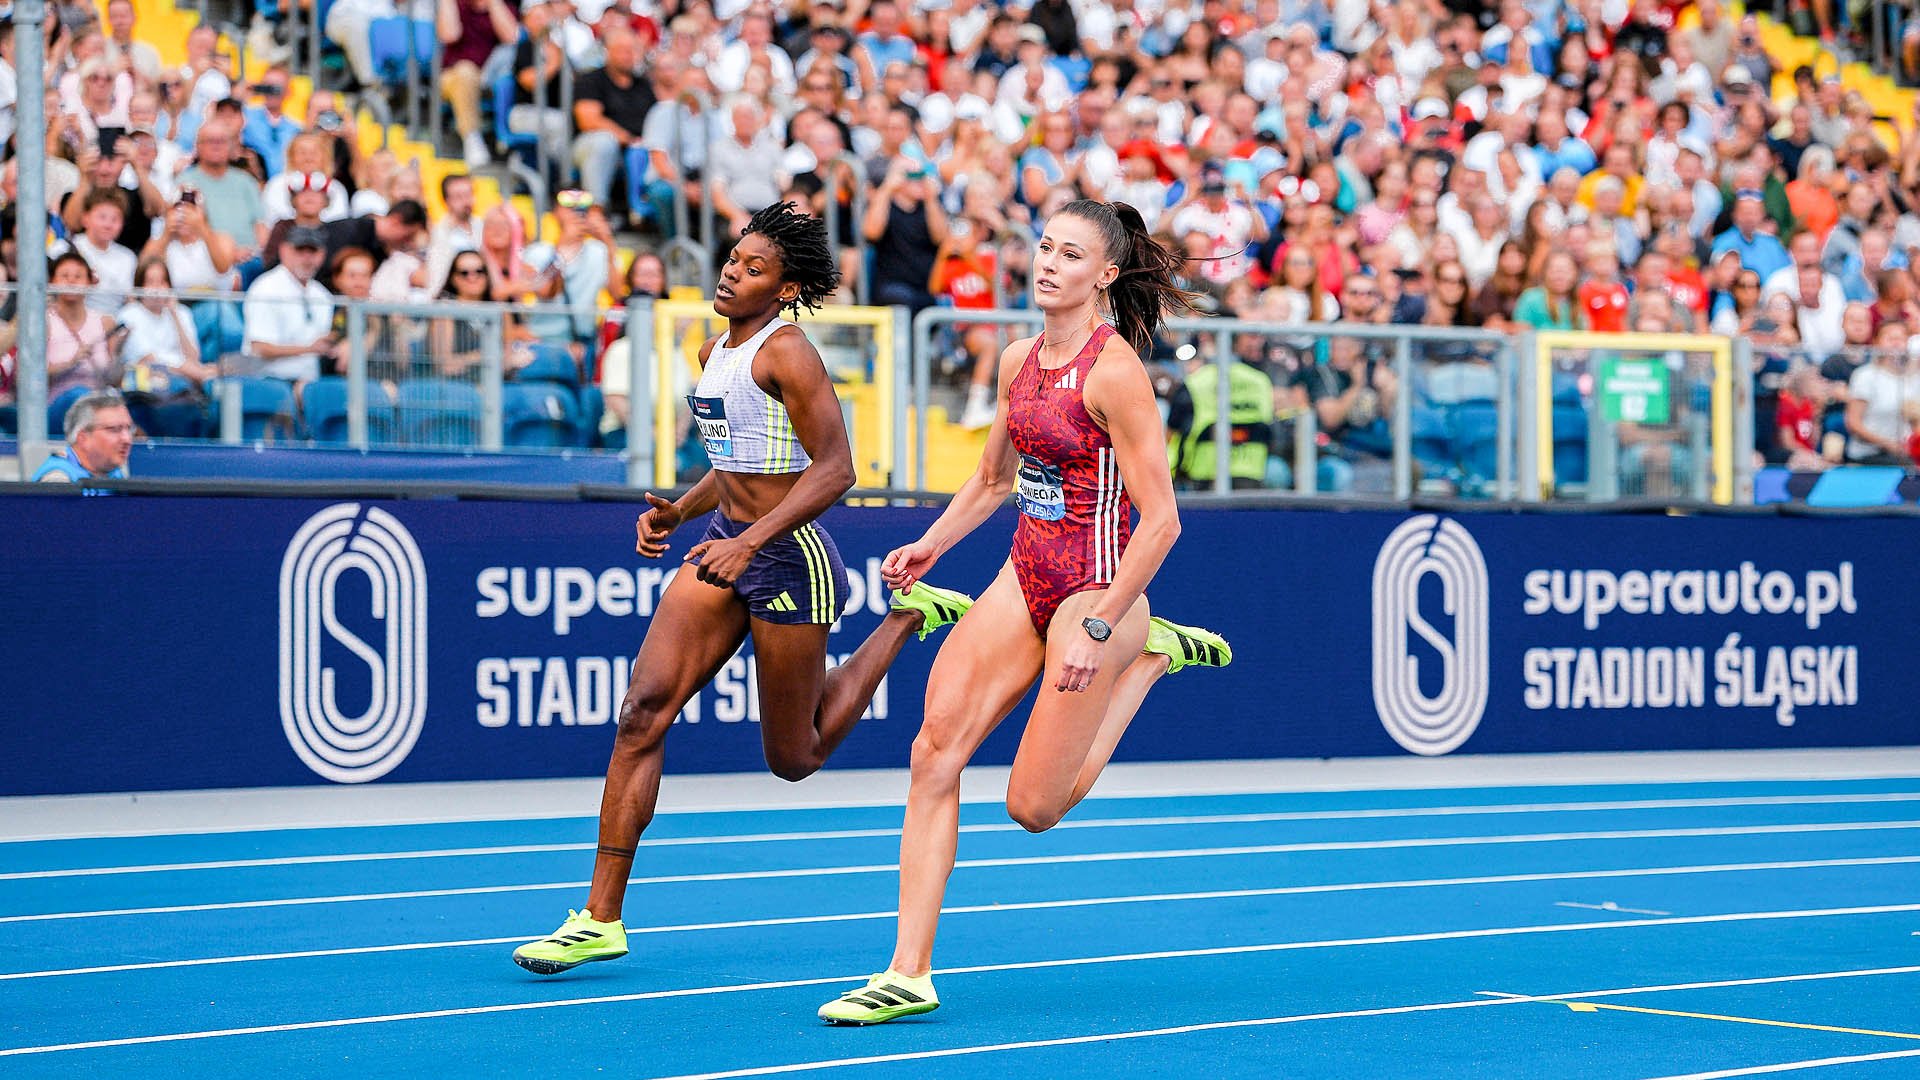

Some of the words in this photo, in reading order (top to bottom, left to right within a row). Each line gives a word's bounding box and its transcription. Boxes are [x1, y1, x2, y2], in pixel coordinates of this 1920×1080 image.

[1523, 561, 1857, 630] superauto.pl
[1524, 646, 1705, 709] STADION
[1714, 632, 1858, 727] ŚLĄSKI
